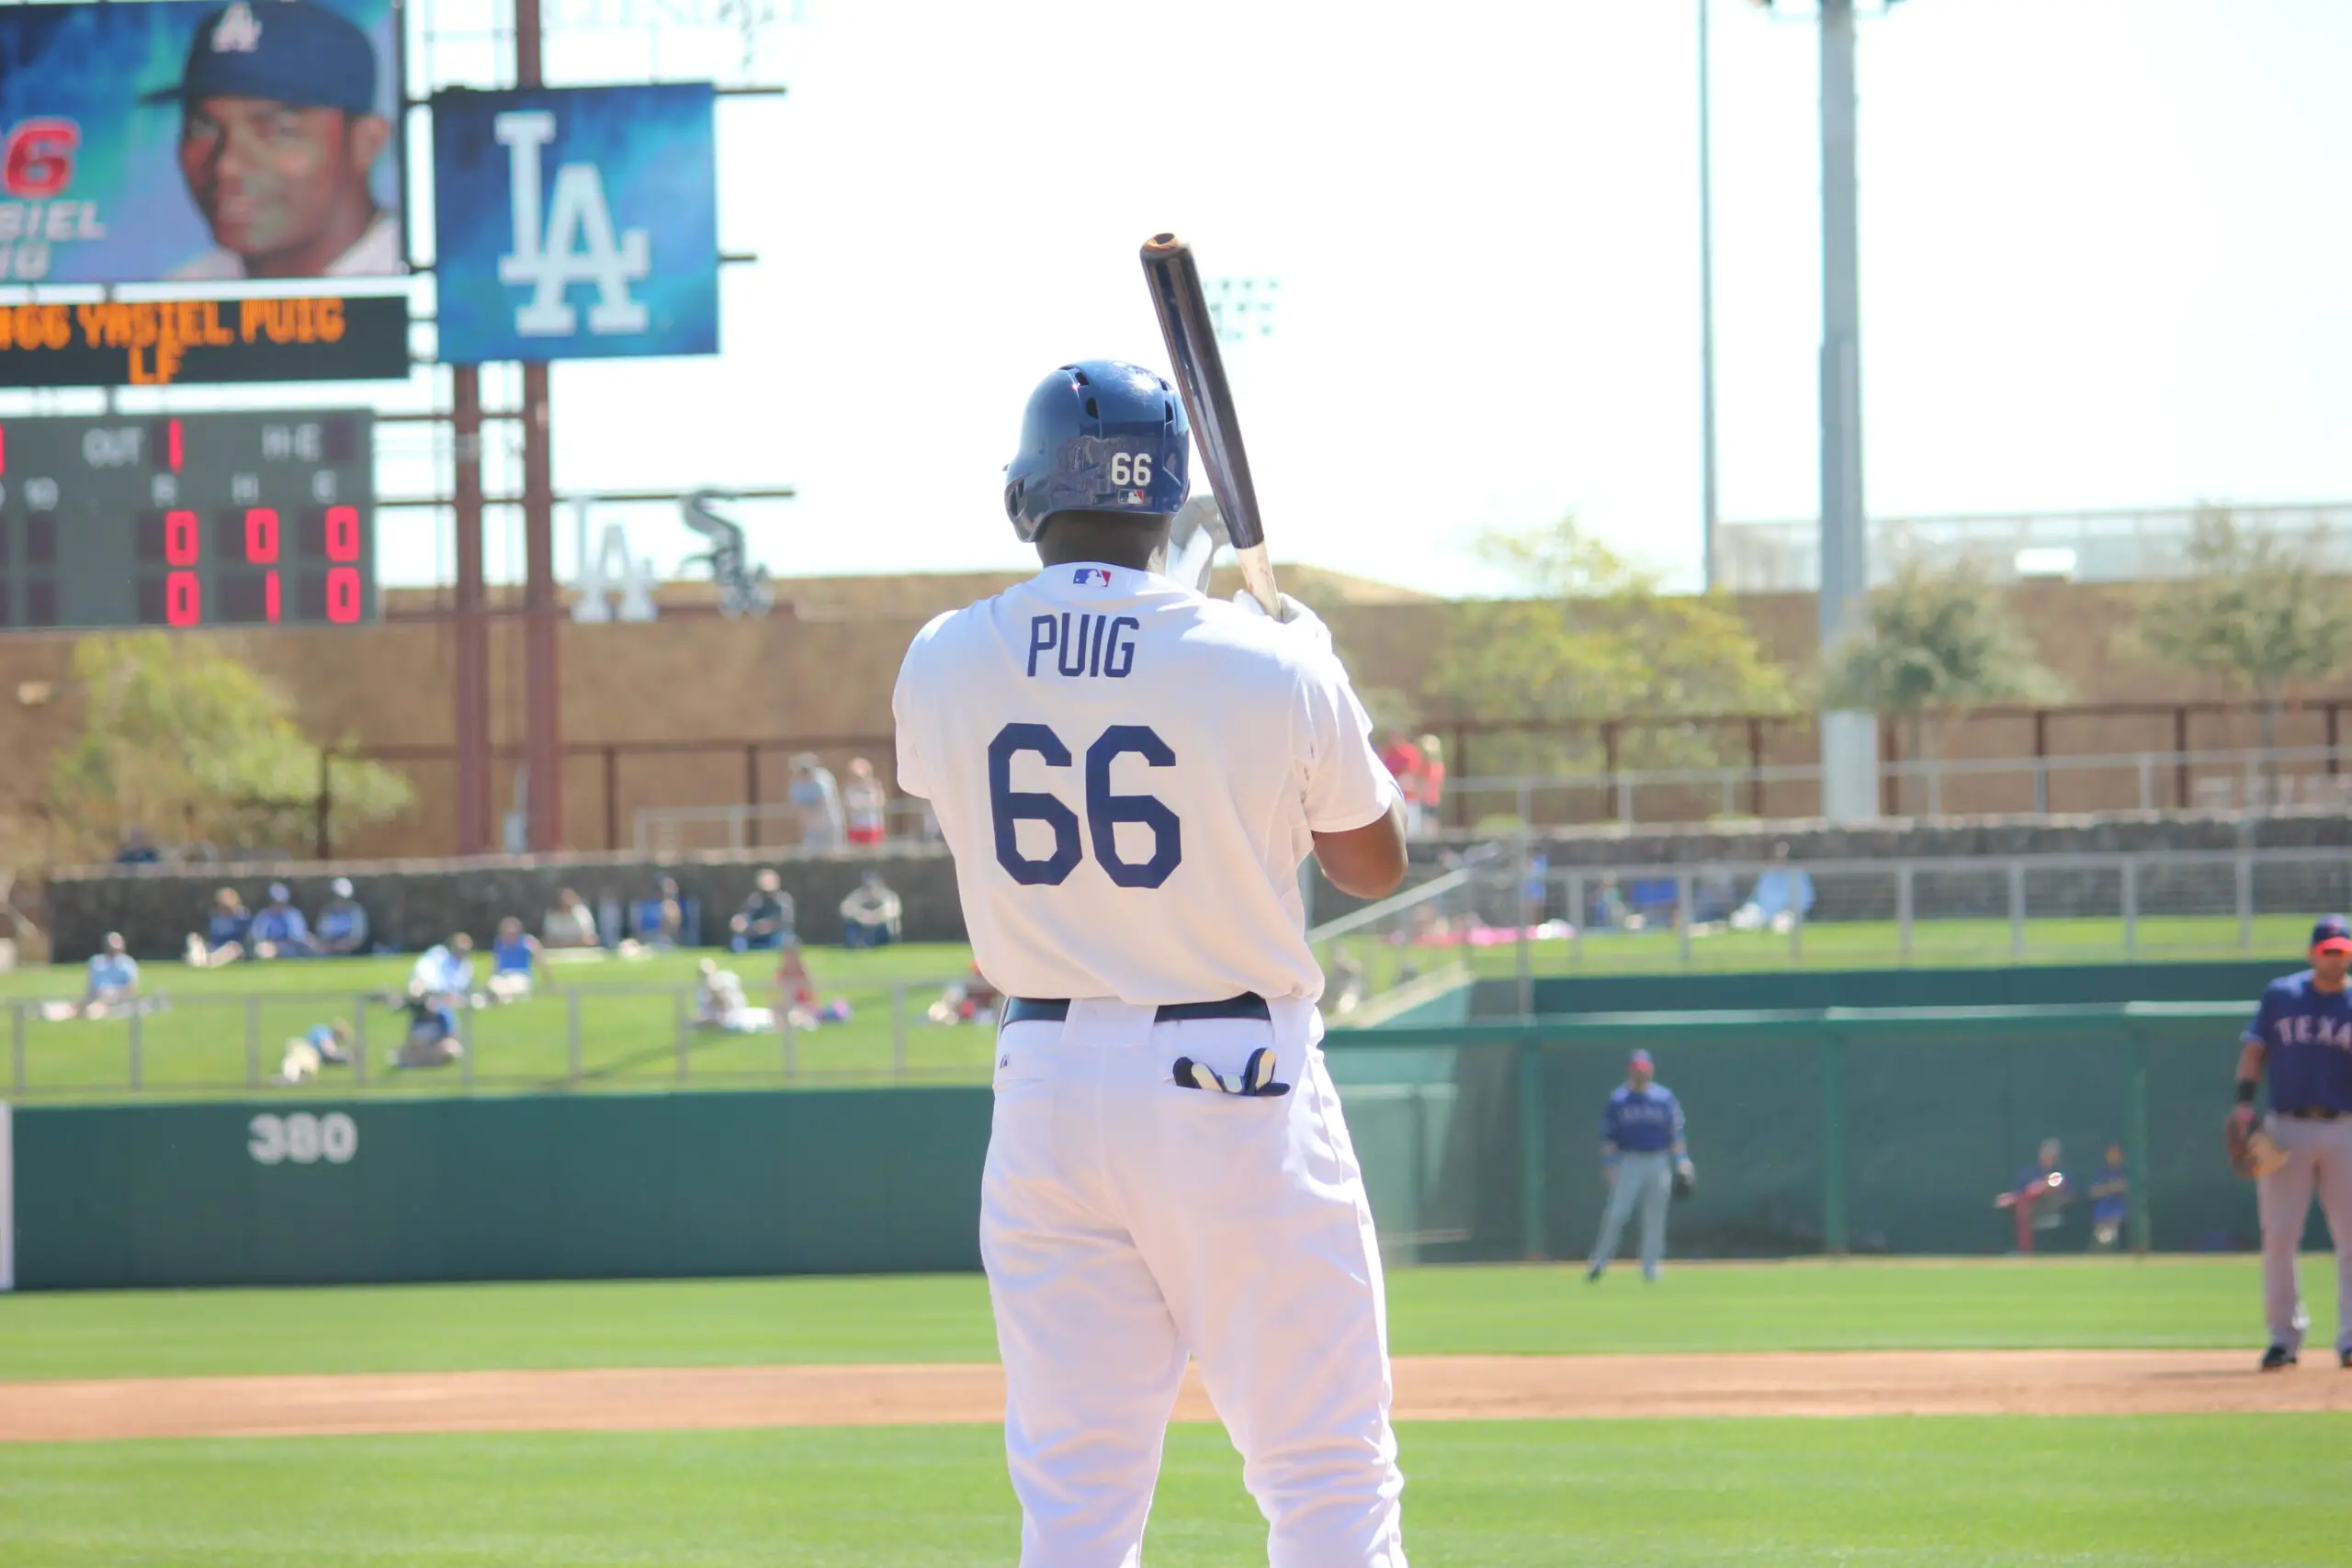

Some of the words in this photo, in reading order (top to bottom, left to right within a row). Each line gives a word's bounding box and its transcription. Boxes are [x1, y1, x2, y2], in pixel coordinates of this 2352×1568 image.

[494, 111, 650, 336] LA
[240, 296, 345, 344] PUIG
[128, 340, 184, 385] LF
[83, 426, 145, 468] OUT
[167, 418, 184, 475] 1
[1111, 452, 1153, 487] 66
[164, 509, 199, 567] 0
[244, 507, 279, 565] 0
[324, 505, 360, 562] 0
[566, 496, 660, 624] LA
[165, 570, 201, 628] 0
[265, 568, 282, 624] 1
[325, 566, 362, 624] 0
[1027, 613, 1140, 678] PUIG
[988, 722, 1182, 889] 66
[247, 1112, 358, 1165] 380
